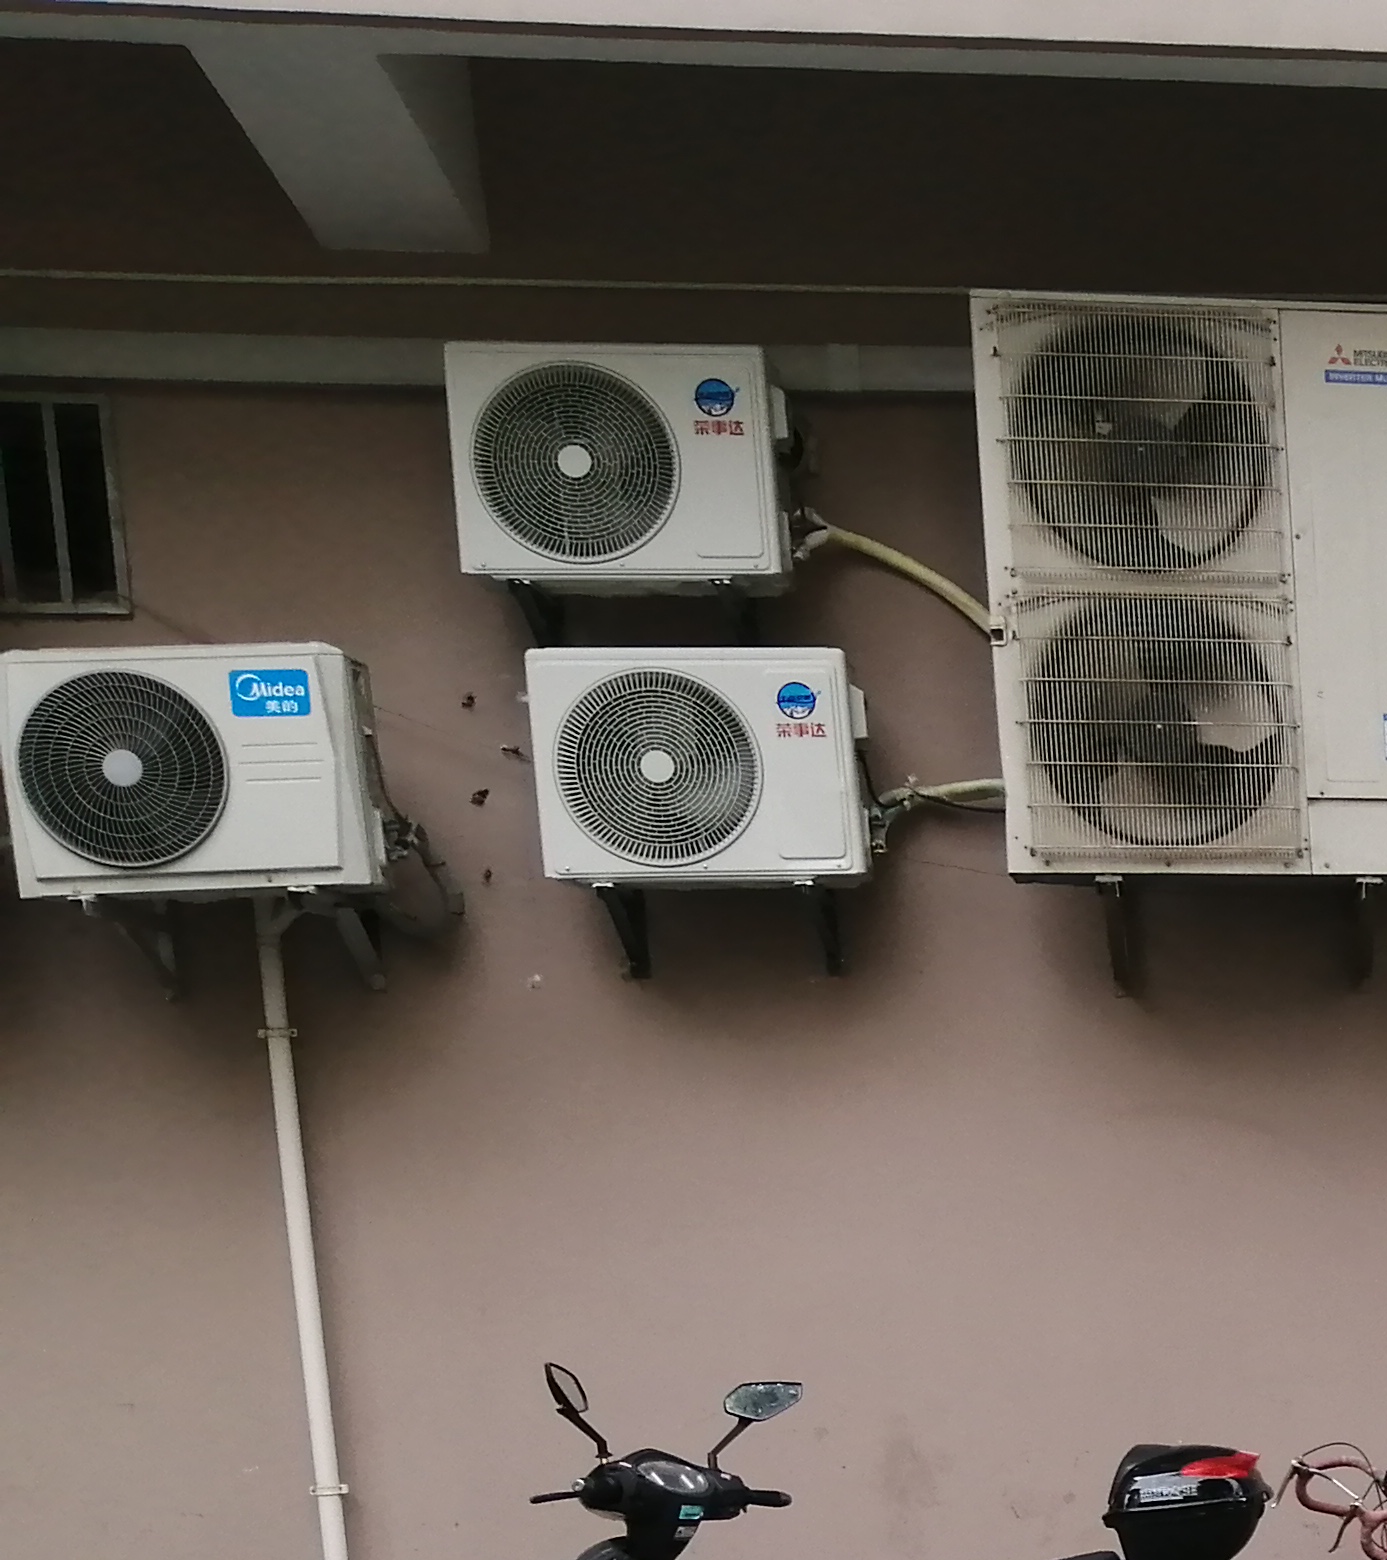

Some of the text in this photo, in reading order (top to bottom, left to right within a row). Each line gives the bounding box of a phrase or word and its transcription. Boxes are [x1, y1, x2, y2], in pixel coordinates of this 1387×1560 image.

[694, 420, 745, 436] 荣事达
[240, 679, 306, 699] Midea
[265, 700, 300, 714] 美的
[776, 722, 827, 738] 荣事达
